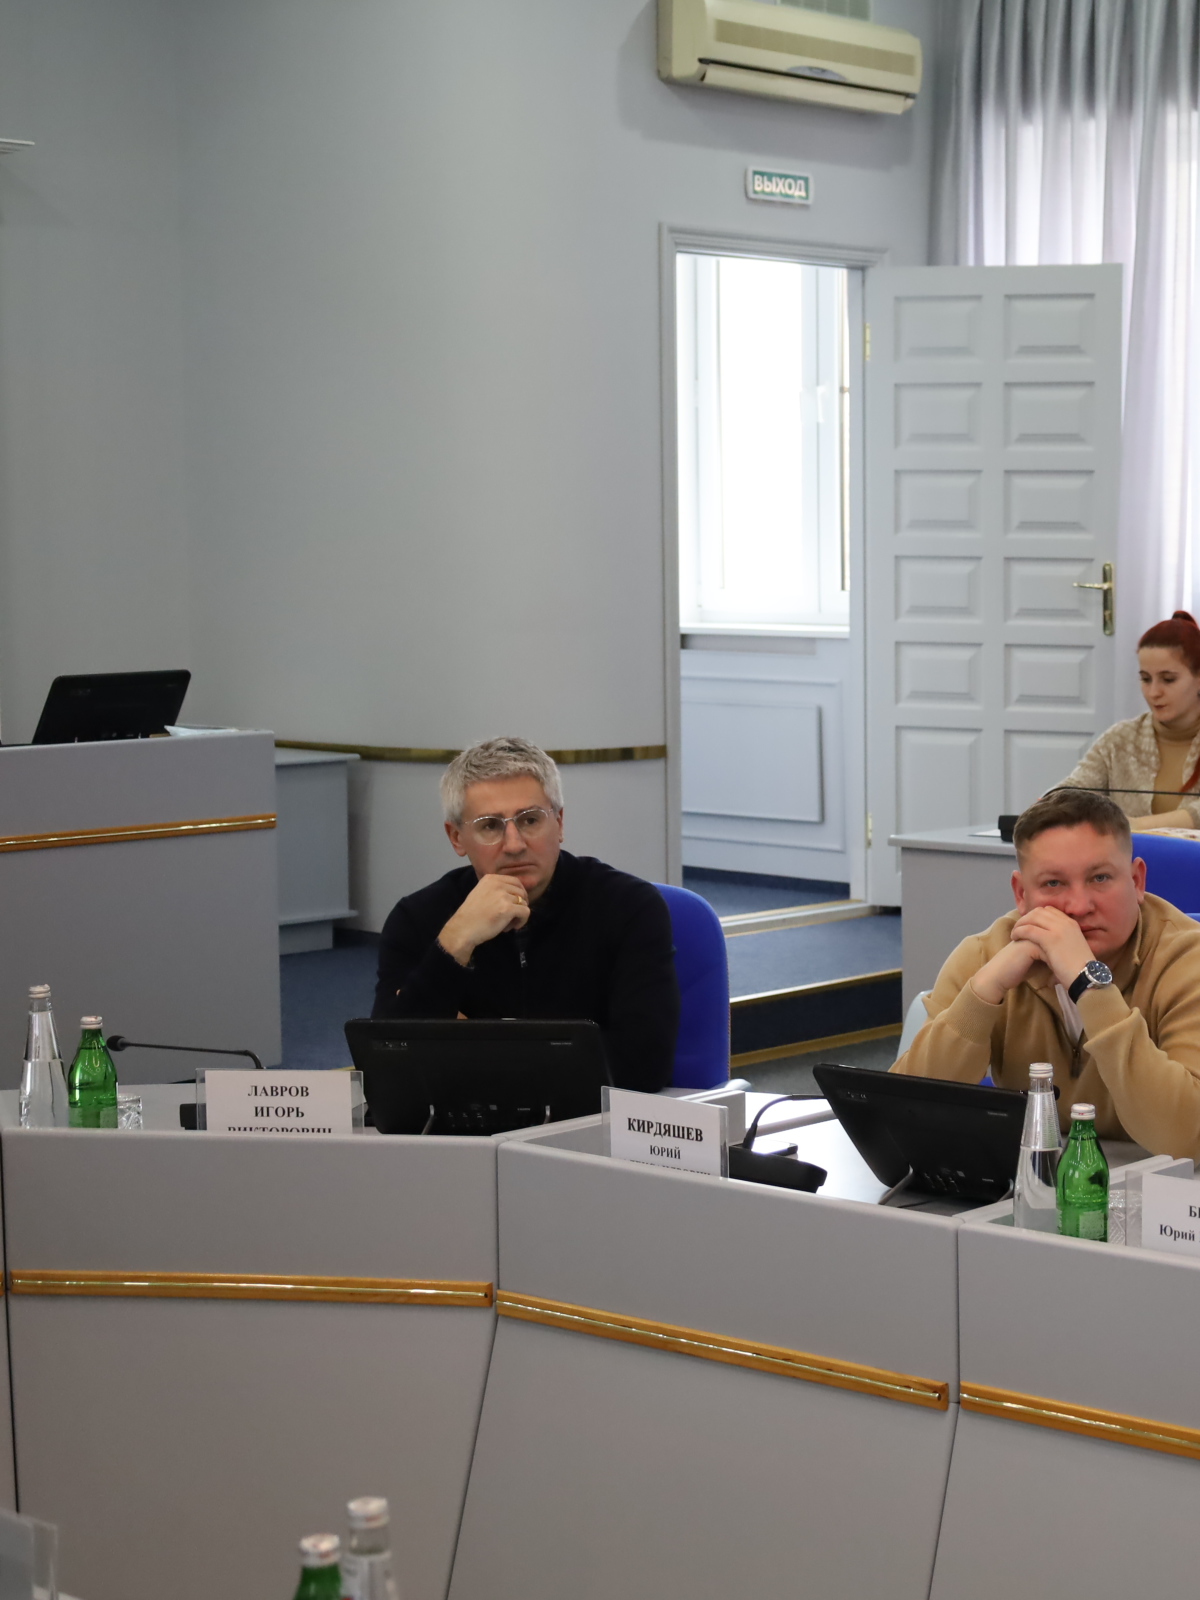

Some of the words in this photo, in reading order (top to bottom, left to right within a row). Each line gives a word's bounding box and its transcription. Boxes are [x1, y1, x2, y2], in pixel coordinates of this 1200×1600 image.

[753, 174, 807, 197] ВЫХОД
[247, 1085, 310, 1098] ЛАВРОВ
[253, 1105, 305, 1118] ИГОРЬ
[627, 1117, 704, 1143] КИРДЯШЕВ
[649, 1144, 681, 1160] ЮРИЙ
[1159, 1224, 1196, 1242] Юрий
